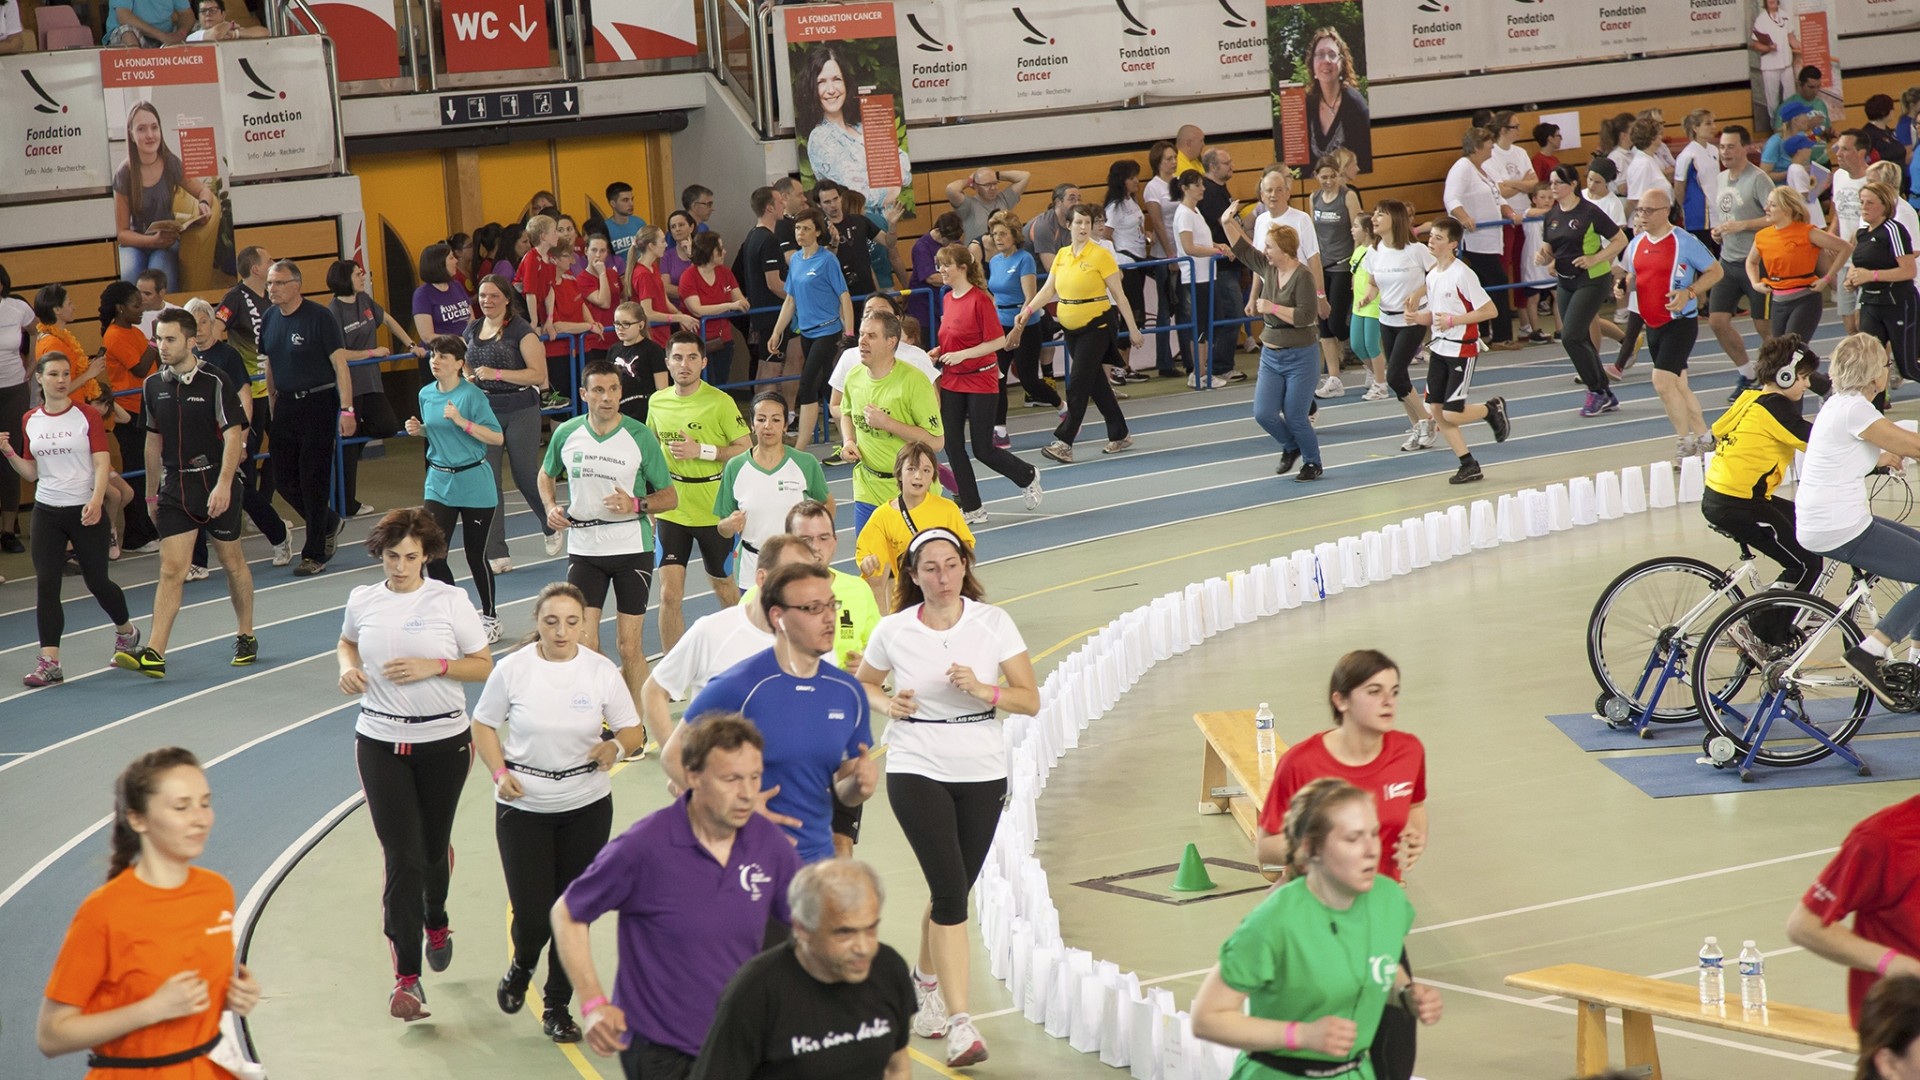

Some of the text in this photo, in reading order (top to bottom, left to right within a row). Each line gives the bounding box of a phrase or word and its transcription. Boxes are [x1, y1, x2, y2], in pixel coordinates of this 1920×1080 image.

[797, 11, 883, 24] LA FONDATION CANCER
[1599, 5, 1646, 18] Fondation
[1690, 10, 1722, 21] Cancer
[1507, 12, 1555, 25] Fondation
[451, 11, 499, 41] WC
[815, 25, 837, 34] VOUS
[1412, 21, 1462, 35] Fondation
[1600, 20, 1632, 31] Cancer
[1507, 27, 1540, 38] Cancer
[1218, 37, 1268, 51] Fondation
[1413, 37, 1446, 48] Cancer
[1119, 45, 1170, 58] Fondation
[114, 55, 204, 68] LA FONDATION CANCER
[1017, 54, 1069, 68] Fondation
[1219, 53, 1253, 65] Cancer
[912, 61, 968, 75] Fondation
[1121, 61, 1155, 72] Cancer
[133, 70, 155, 80] VOUS
[1016, 70, 1051, 82] Cancer
[912, 77, 950, 89] Cancer
[243, 110, 302, 126] Fondation
[26, 125, 82, 141] Fondation
[244, 129, 286, 142] Cancer
[25, 144, 63, 157] Cancer
[247, 152, 260, 160] Info
[263, 150, 276, 158] Aide
[24, 164, 86, 176] Info Aide Recherche
[439, 302, 457, 314] RUN
[37, 431, 72, 440] ALLEN
[37, 447, 72, 456] OVERY
[598, 456, 626, 466] PARIBAS
[531, 768, 546, 777] POUR
